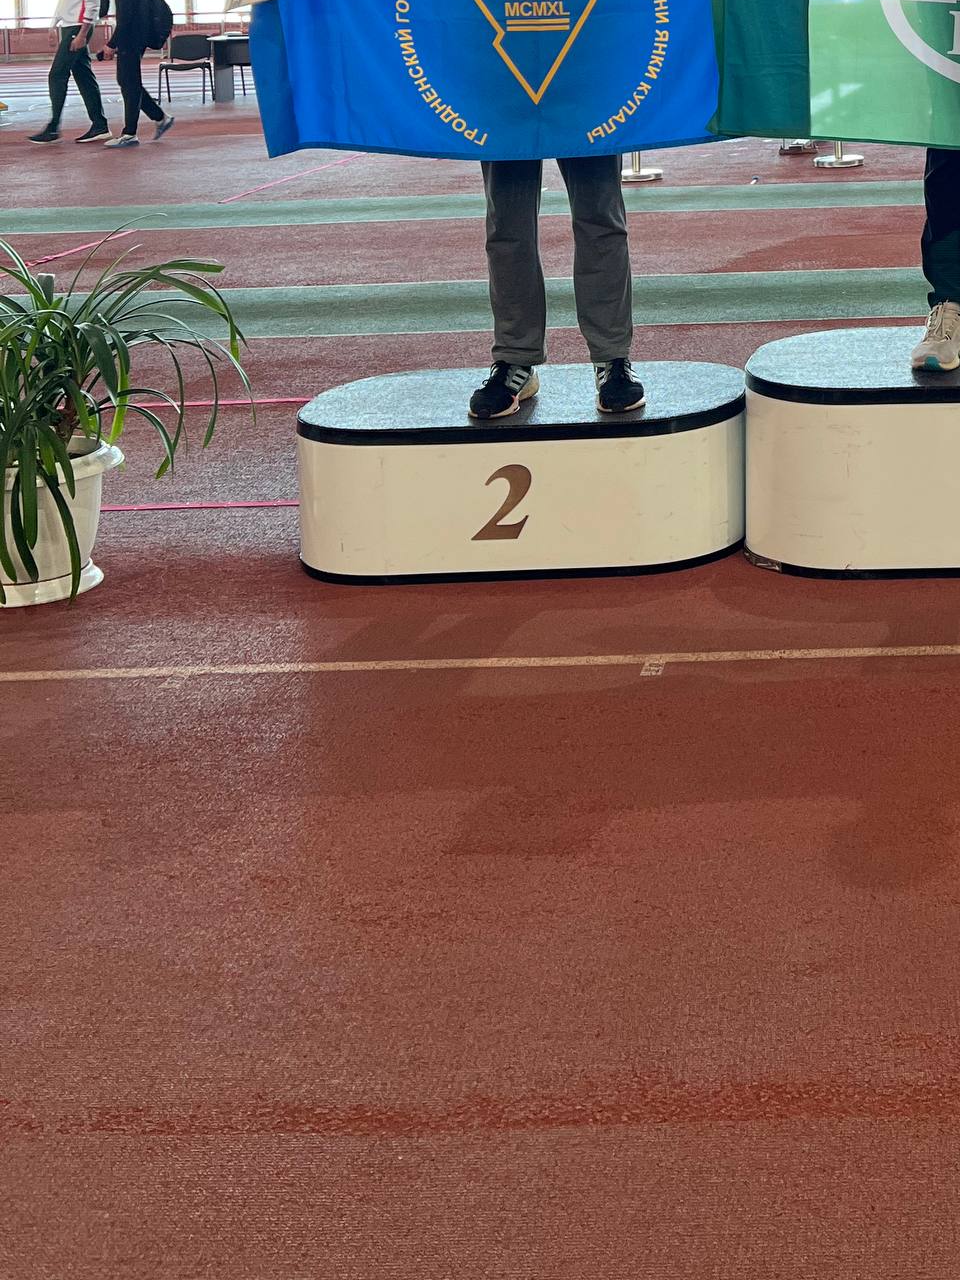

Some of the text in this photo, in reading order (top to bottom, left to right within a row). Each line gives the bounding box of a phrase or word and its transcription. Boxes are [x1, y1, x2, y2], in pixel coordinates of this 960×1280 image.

[504, 1, 571, 17] MCMXL
[644, 28, 670, 80] ЯНКИ
[394, 28, 488, 147] ГРОДНЕНСКИЙ
[587, 81, 652, 144] КУПАЛЫ
[471, 463, 533, 541] 2
